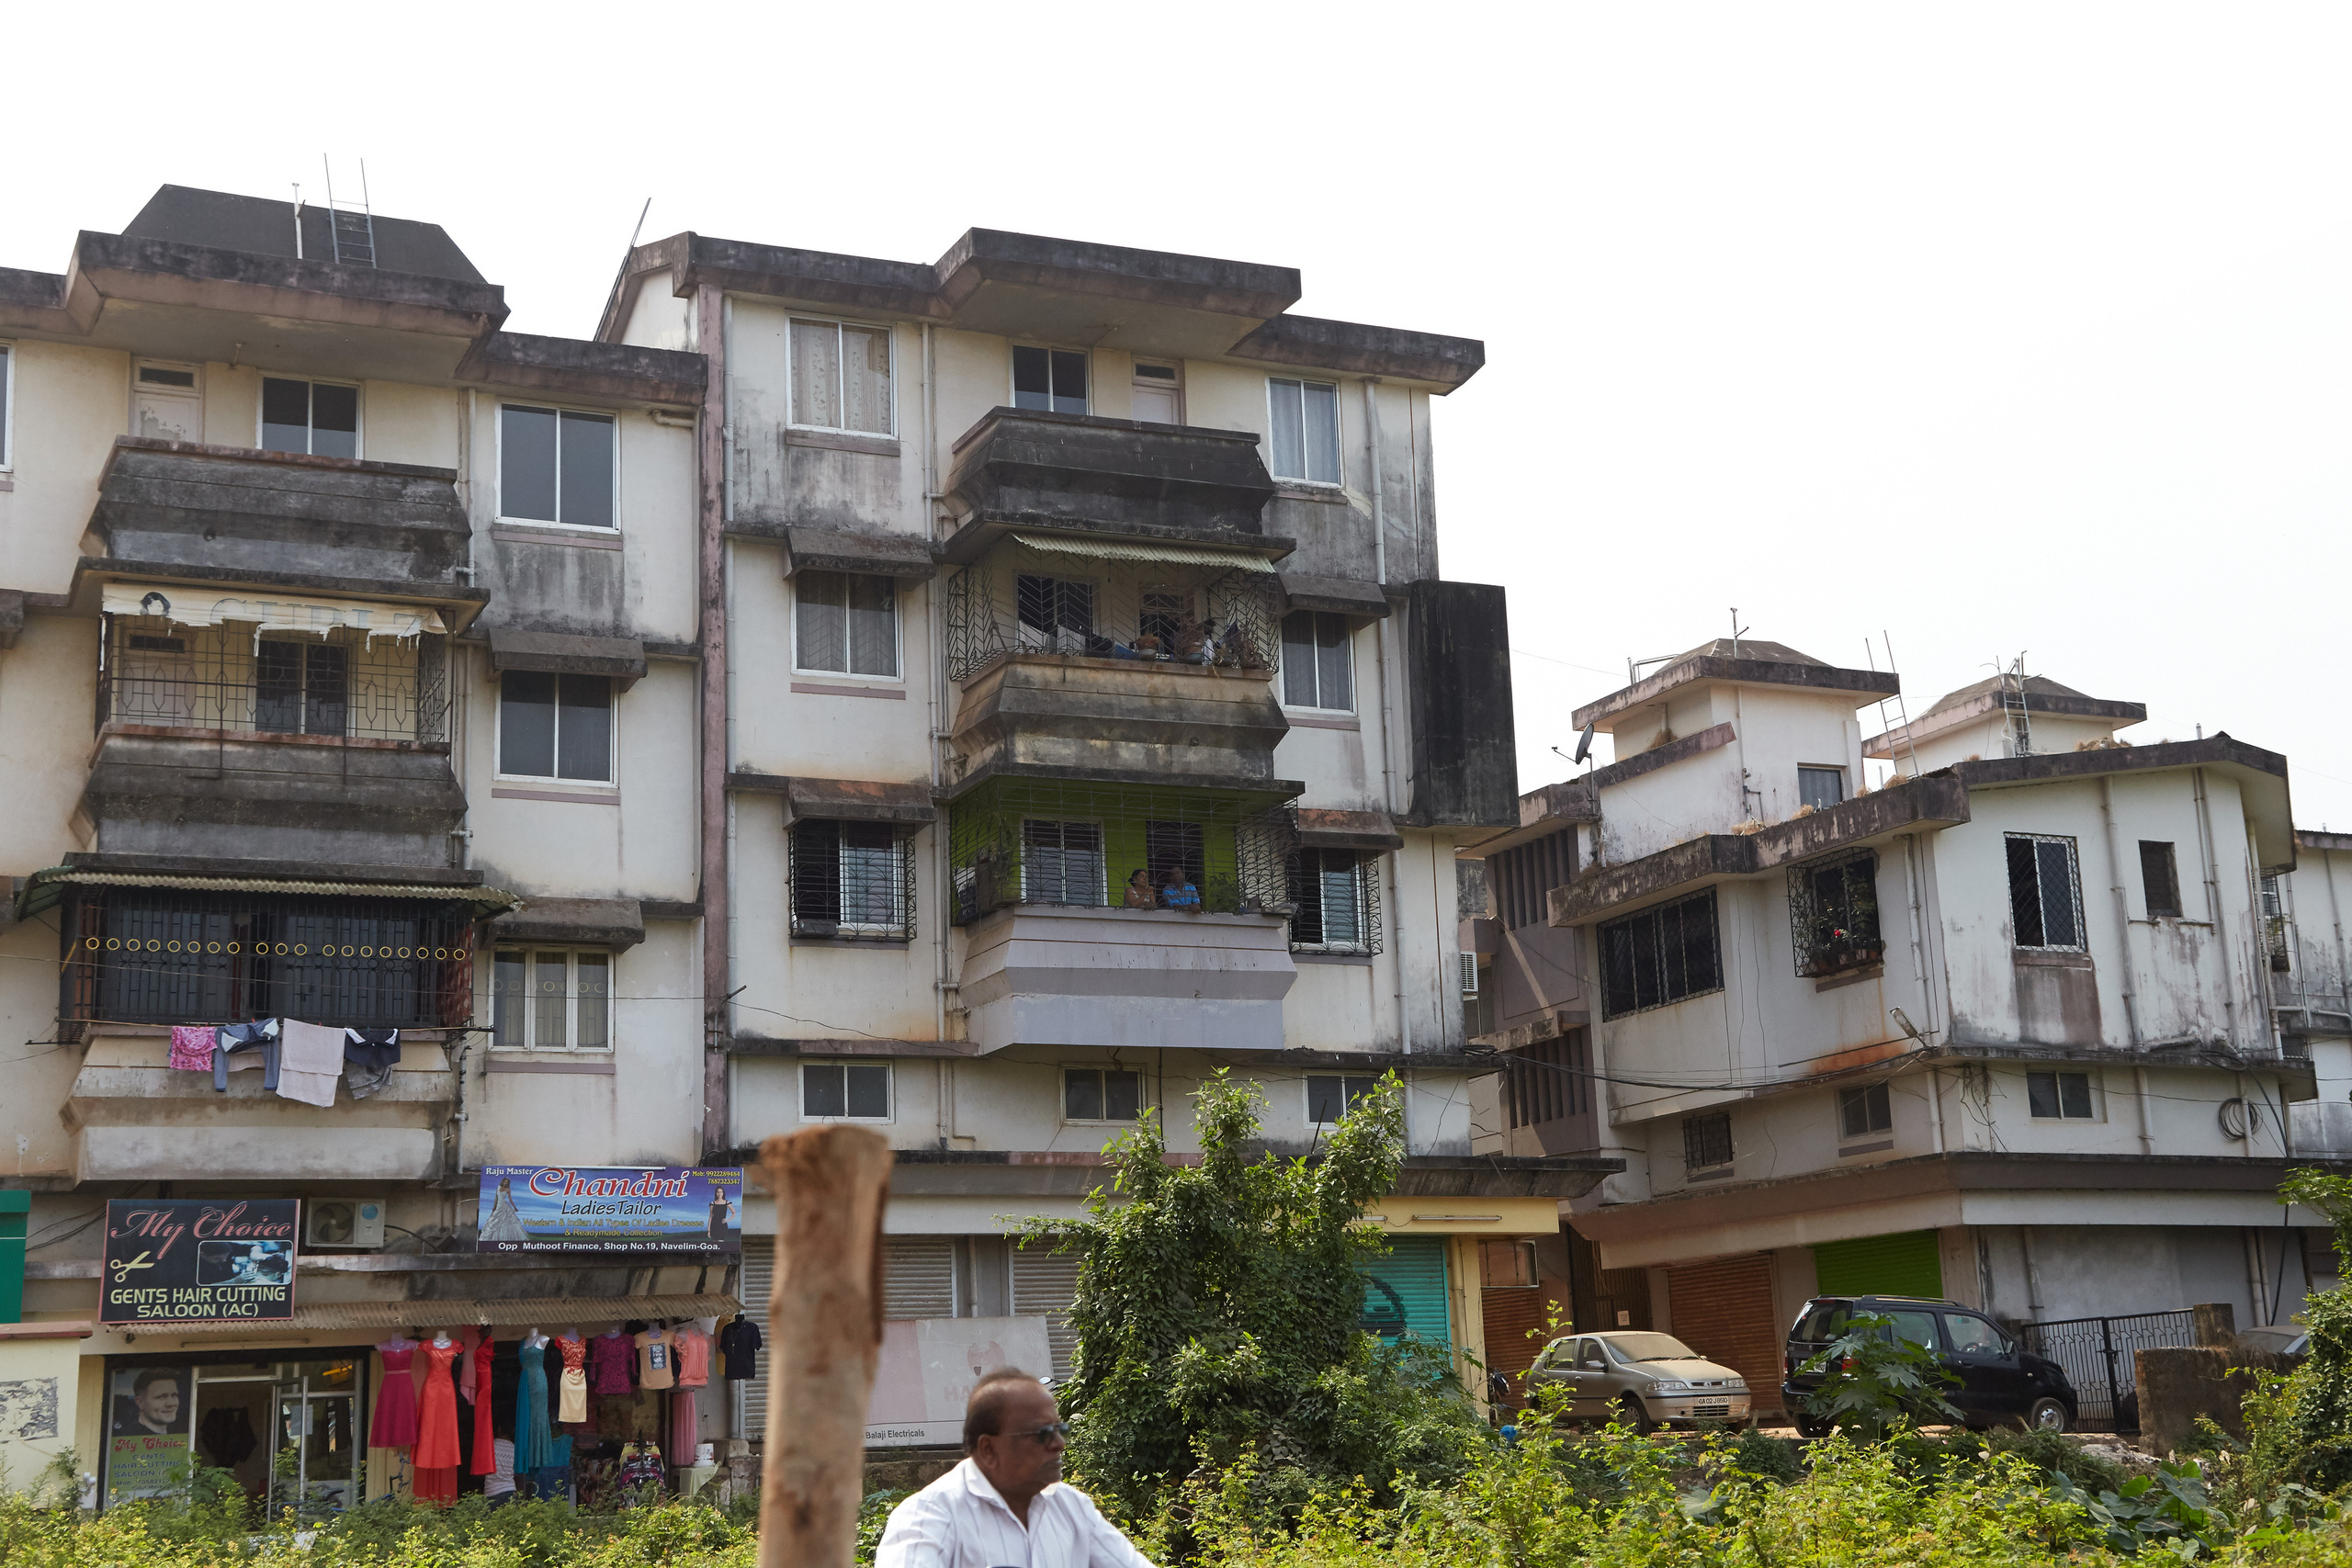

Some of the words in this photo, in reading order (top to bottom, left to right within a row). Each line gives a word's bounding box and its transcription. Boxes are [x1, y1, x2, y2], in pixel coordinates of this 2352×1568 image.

[485, 1168, 504, 1176] Raju
[529, 1168, 690, 1198] Chandni
[523, 1218, 557, 1227] Western
[558, 1219, 565, 1227] &
[567, 1218, 592, 1227] Indian
[593, 1219, 604, 1227] All
[605, 1219, 629, 1229] Types
[631, 1219, 641, 1227] Of
[643, 1219, 670, 1227] Ladies
[671, 1219, 705, 1227] Dresses
[109, 1206, 187, 1260] My
[192, 1201, 292, 1239] Choice
[572, 1229, 621, 1238] Readymade
[498, 1242, 518, 1251] Opp
[523, 1242, 561, 1250] Muthoot
[563, 1242, 602, 1251] Finance,
[604, 1242, 628, 1251] Shop
[630, 1242, 659, 1251] No.19,
[661, 1242, 721, 1250] Navelim-Goa.
[110, 1288, 168, 1304] GENTS
[172, 1287, 211, 1303] HAIR
[216, 1286, 287, 1303] CUTTING
[137, 1303, 217, 1318] SALOON
[222, 1303, 259, 1318] (AC)
[865, 1430, 887, 1440] Balaji
[888, 1429, 925, 1438] Electricals
[114, 1438, 137, 1452] My
[141, 1437, 185, 1450] Choice
[114, 1470, 155, 1478] SALOON
